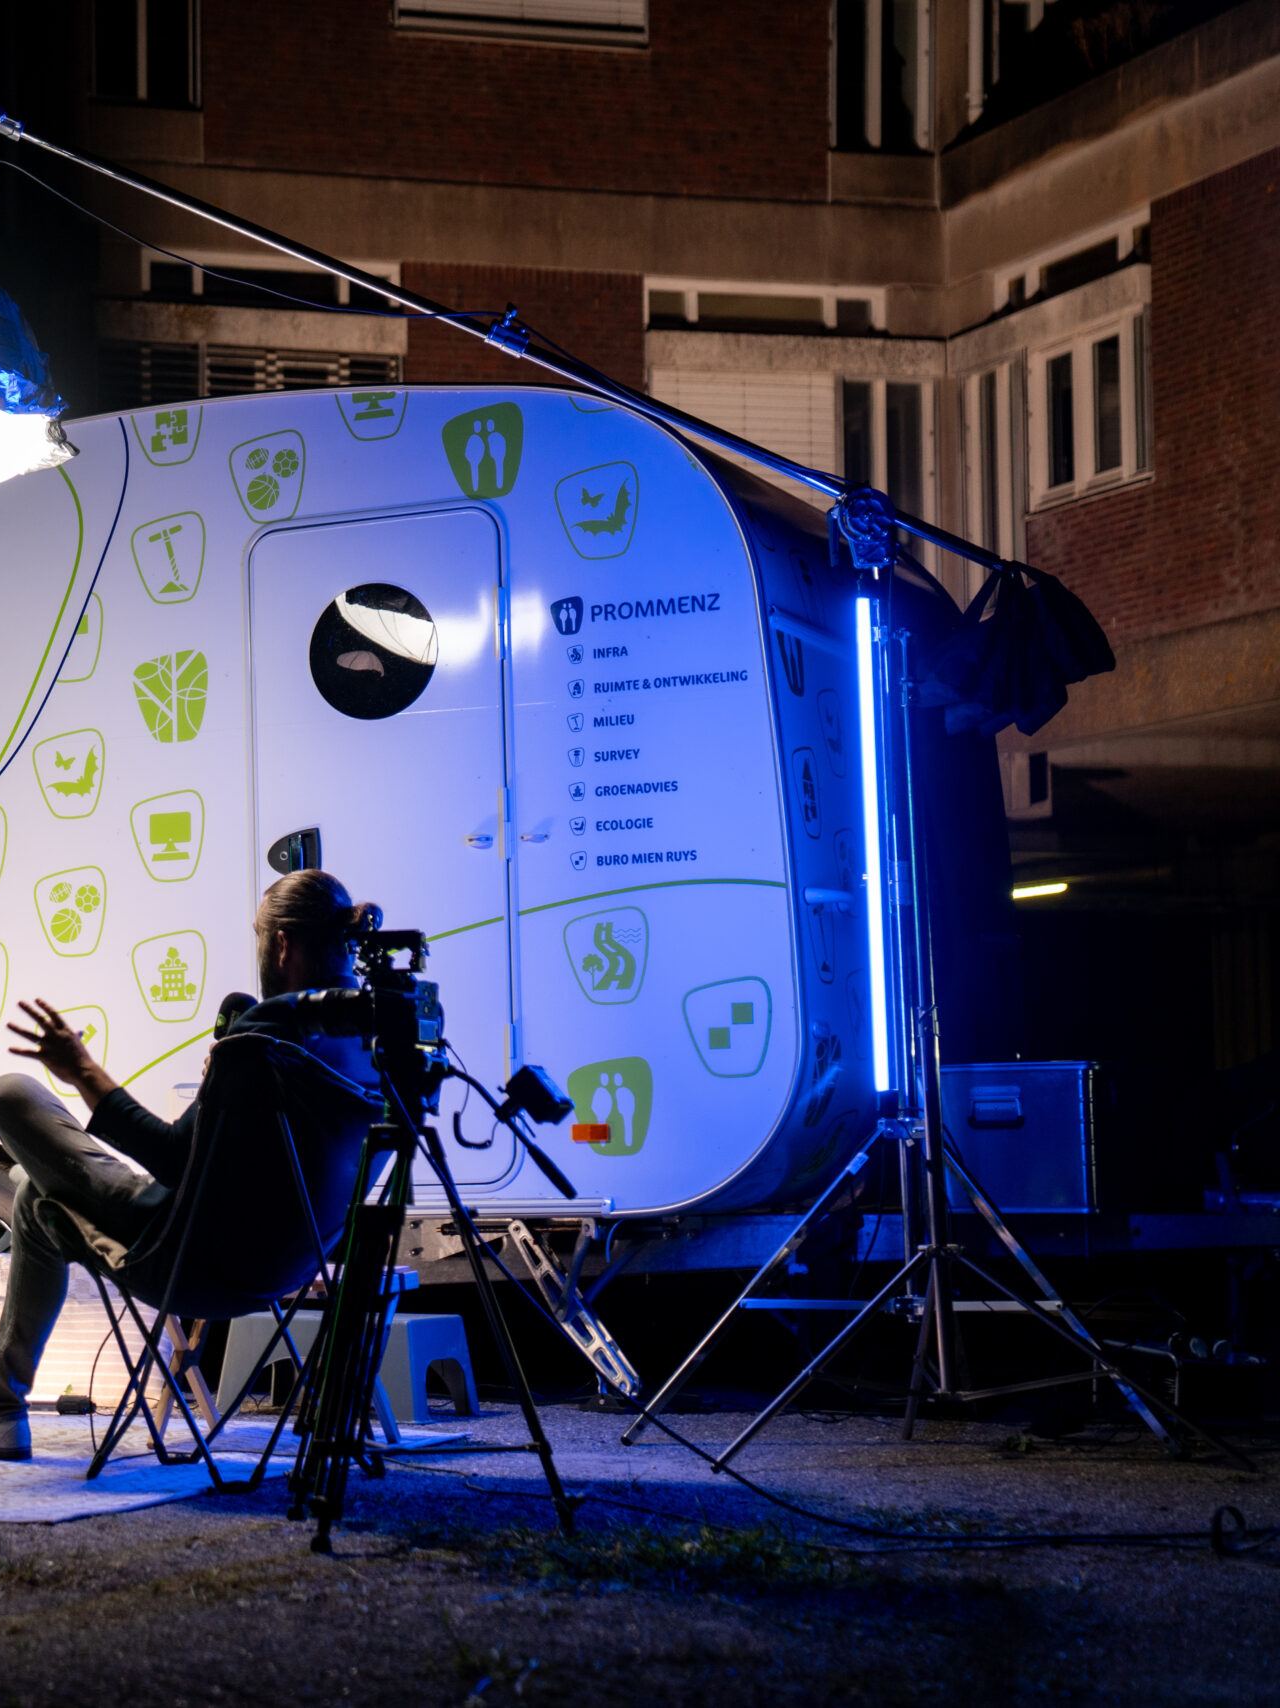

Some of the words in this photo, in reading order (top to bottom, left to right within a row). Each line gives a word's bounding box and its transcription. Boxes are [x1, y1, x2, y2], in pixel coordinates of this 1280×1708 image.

[590, 593, 720, 622] PROMMENZ
[593, 646, 628, 659] INFRA
[593, 679, 640, 694] RUIMTE
[642, 679, 652, 690] &
[653, 670, 748, 688] ONTWIKKELING
[593, 714, 635, 728] MILIEU
[593, 748, 640, 762] SURVEY
[595, 781, 678, 797] GROENADVIES
[596, 817, 653, 832] ECOLOGIE
[596, 853, 630, 866] BURO
[631, 852, 663, 865] MIEN
[666, 850, 697, 863] RUYS
